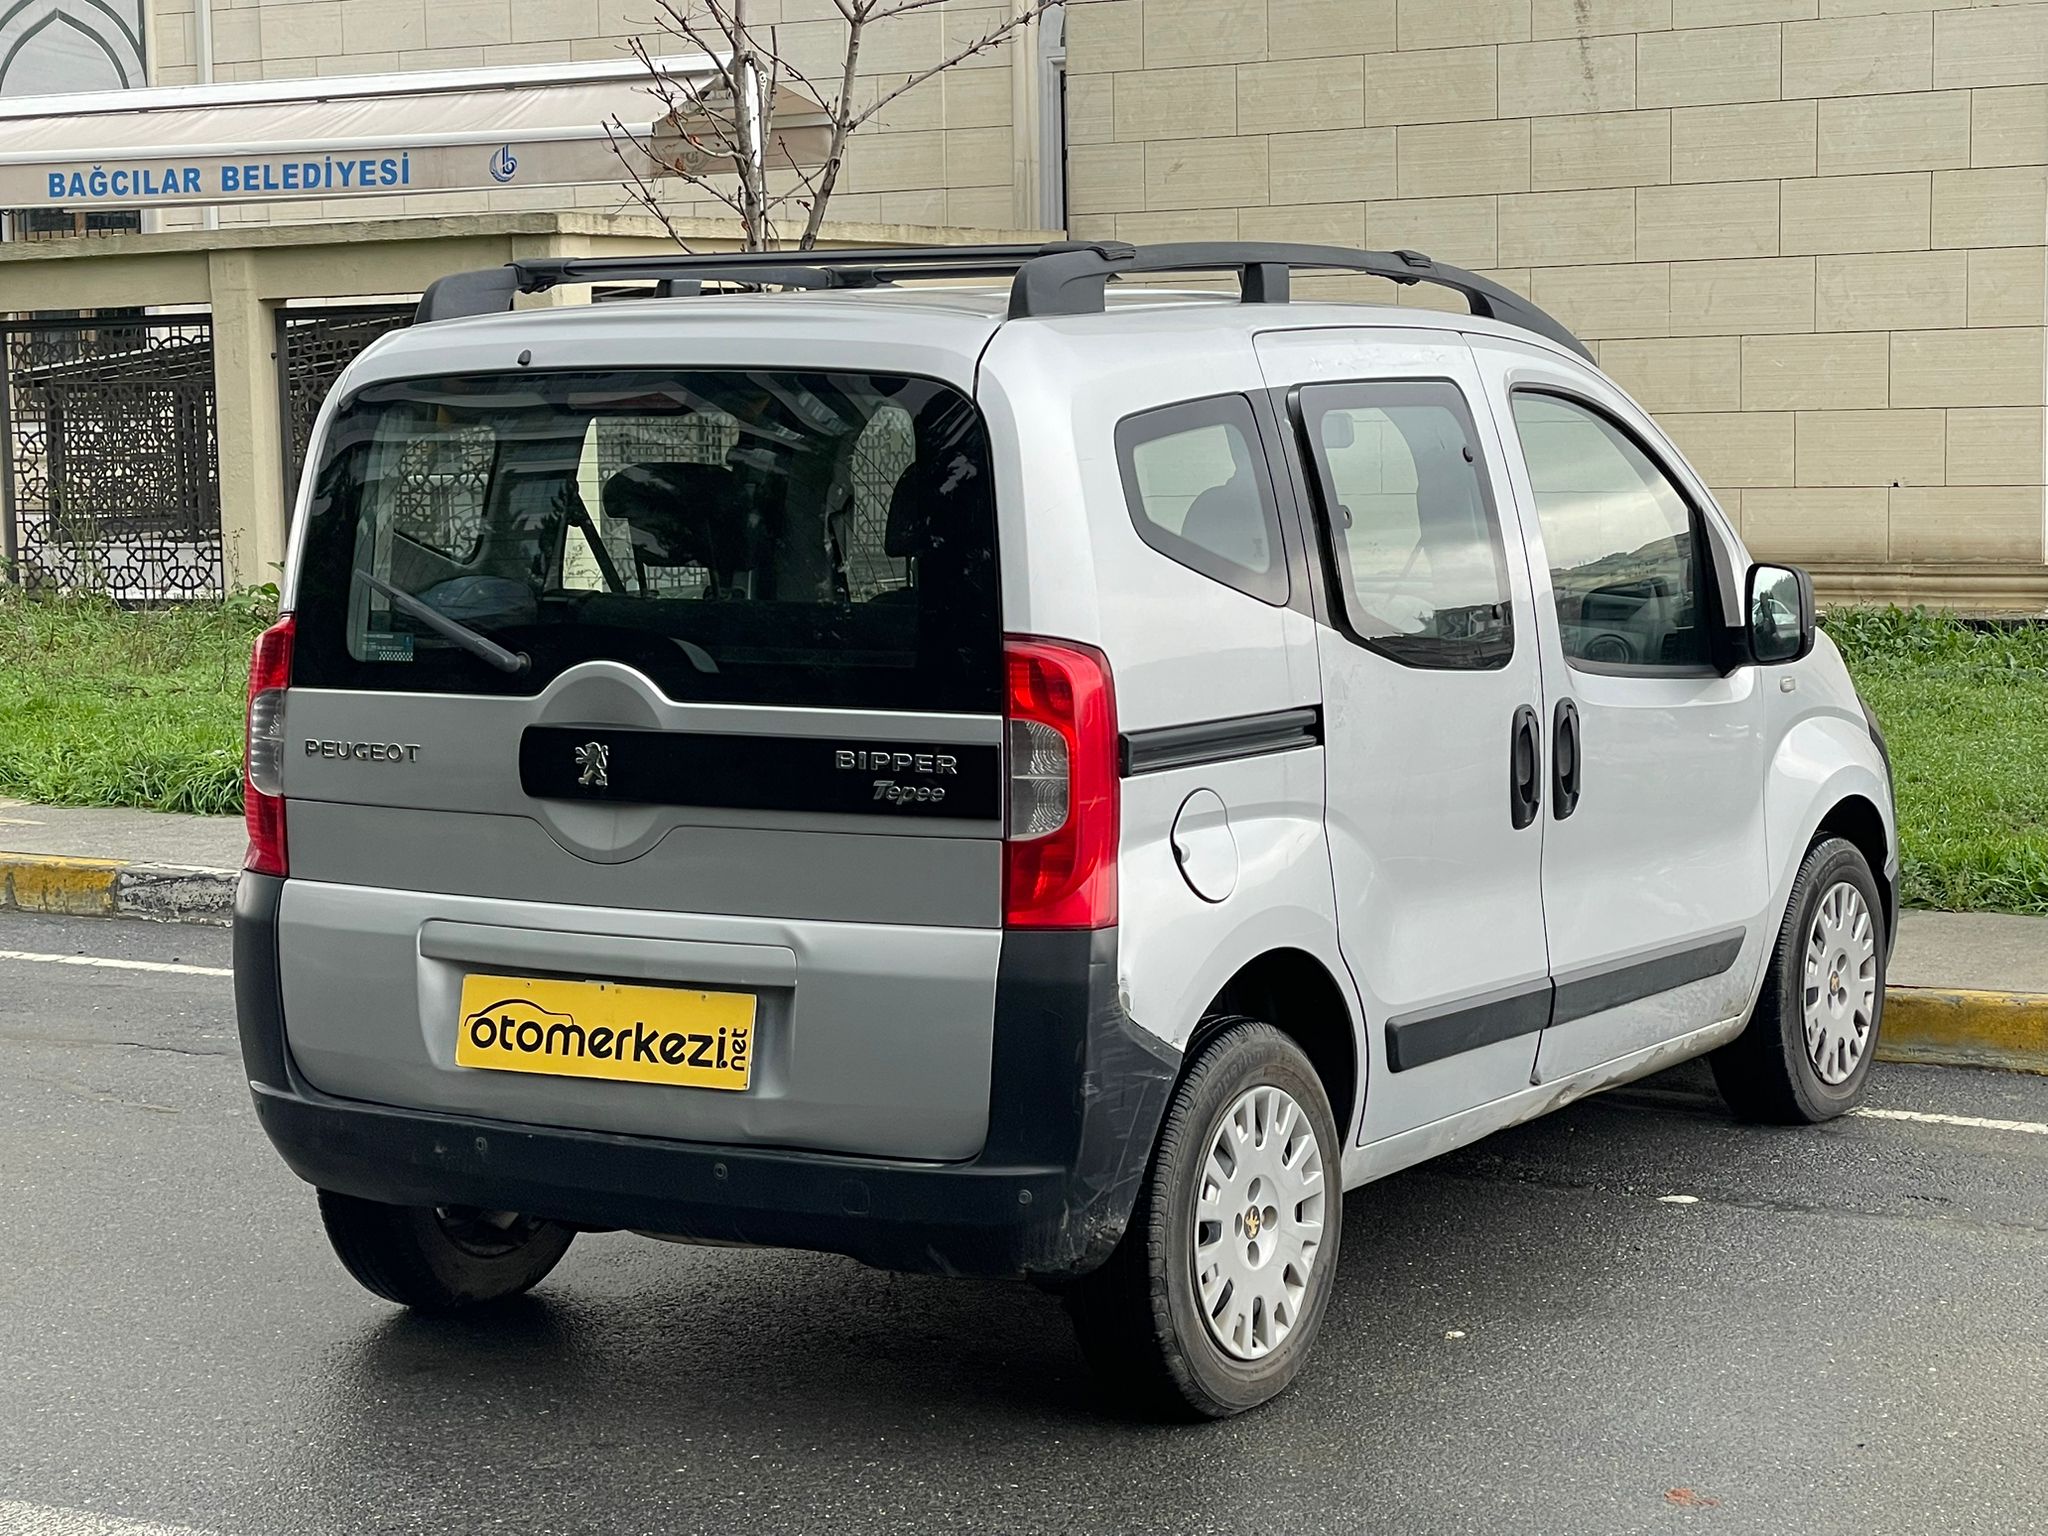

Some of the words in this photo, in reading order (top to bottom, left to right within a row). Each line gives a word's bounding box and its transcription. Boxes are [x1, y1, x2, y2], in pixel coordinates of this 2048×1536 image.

[48, 165, 202, 199] BAĞCILAR
[220, 151, 410, 193] BELEDİYESİ
[304, 738, 421, 763] PEUGEOT
[835, 750, 958, 775] BIPPER
[872, 780, 946, 805] Tepee
